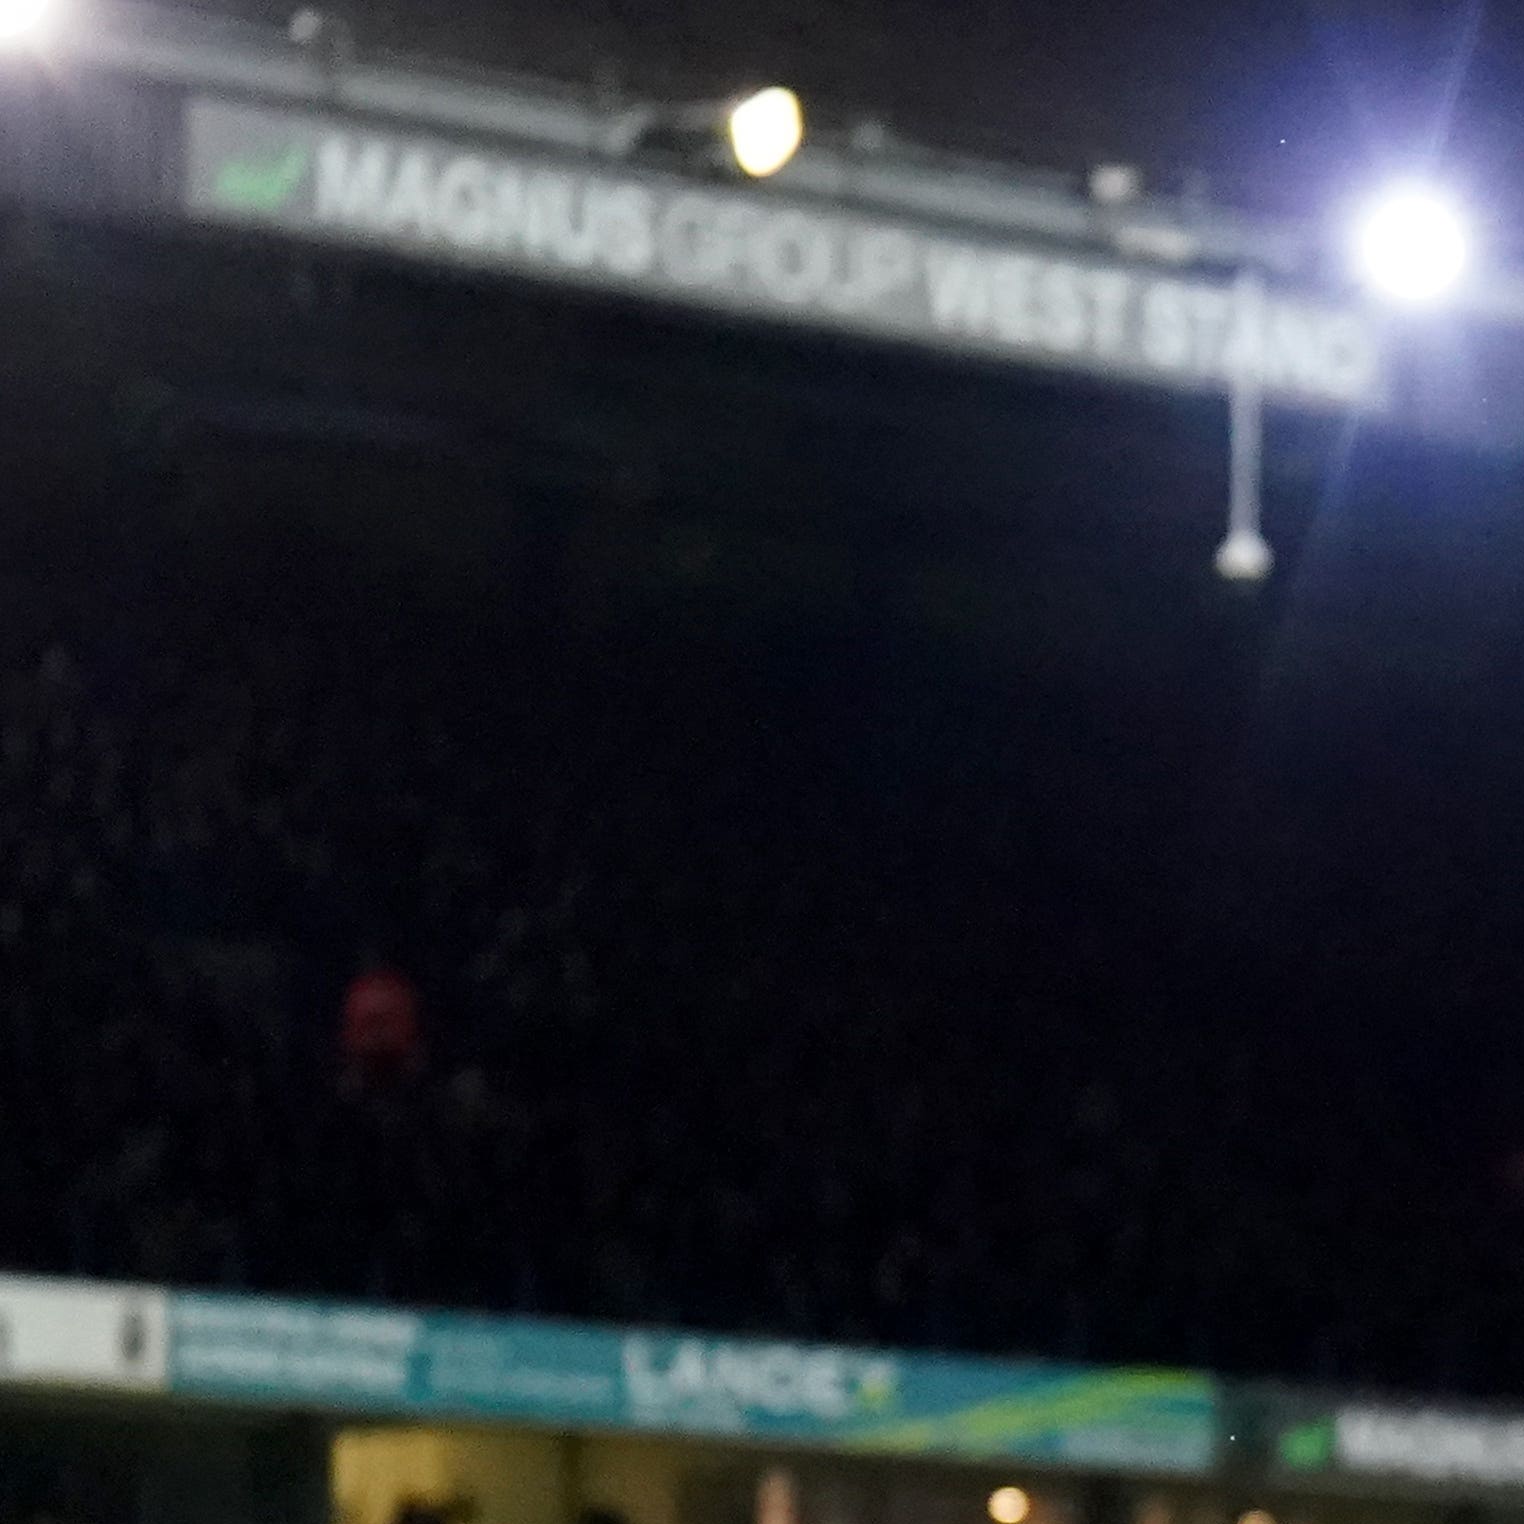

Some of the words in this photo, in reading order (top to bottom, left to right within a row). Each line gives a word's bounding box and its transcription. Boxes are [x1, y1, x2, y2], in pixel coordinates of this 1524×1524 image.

[315, 135, 656, 277] MAGNUS
[658, 195, 916, 318] GROUP
[924, 245, 1133, 355] WEST
[1143, 280, 1380, 394] STAND
